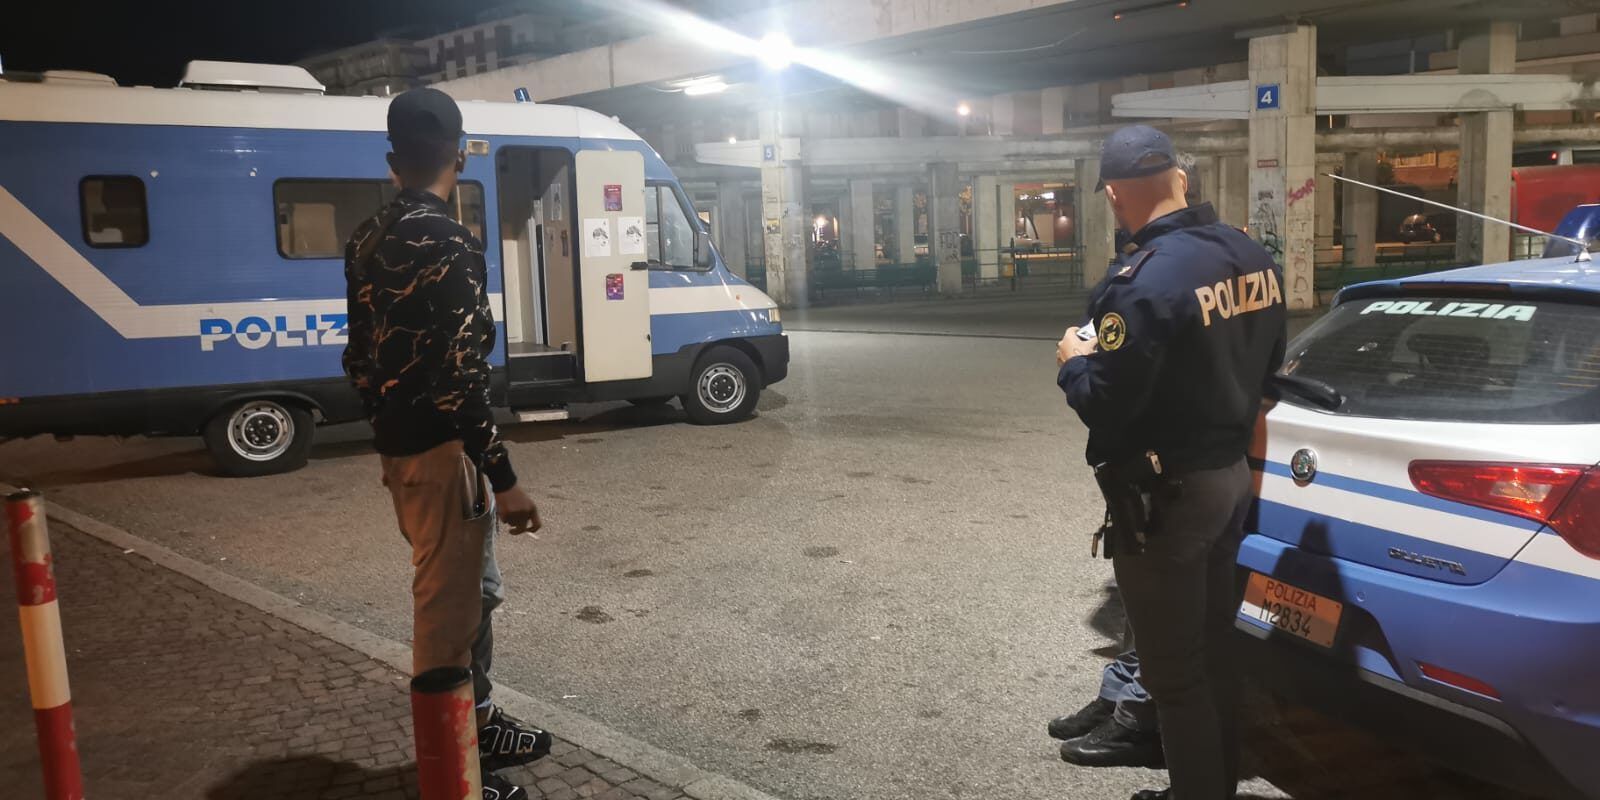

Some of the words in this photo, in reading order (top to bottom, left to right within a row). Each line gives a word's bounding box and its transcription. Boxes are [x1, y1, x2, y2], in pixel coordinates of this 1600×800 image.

[1261, 90, 1273, 105] 4
[1194, 268, 1283, 327] POLIZIA
[1360, 301, 1538, 322] POLIZIA
[200, 313, 348, 352] POLIZ
[1265, 580, 1317, 612] POLIZIA
[1259, 598, 1313, 637] M2834
